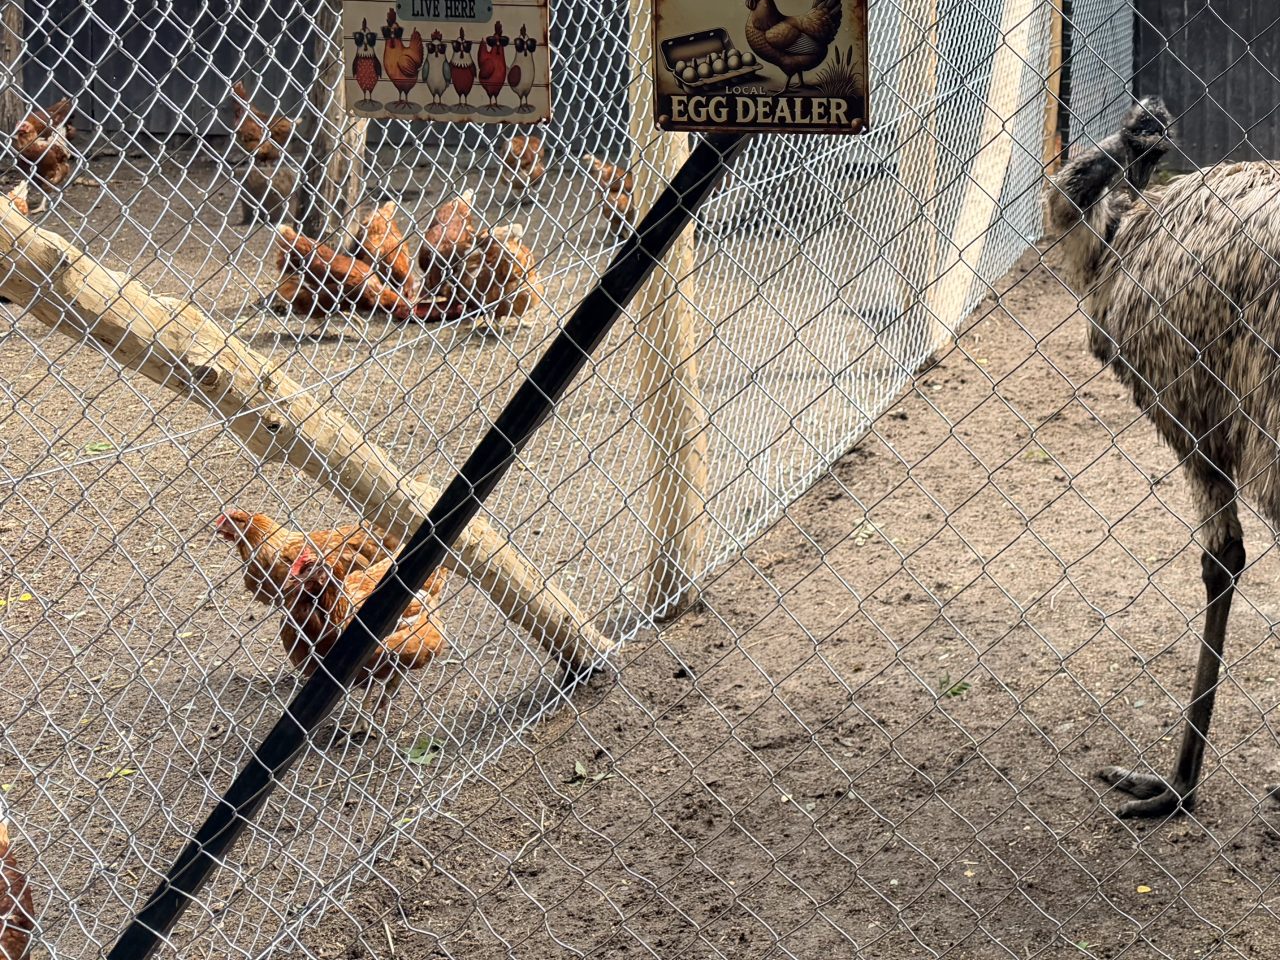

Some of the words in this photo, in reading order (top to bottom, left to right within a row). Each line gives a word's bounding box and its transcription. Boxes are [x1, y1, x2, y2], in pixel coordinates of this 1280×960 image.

[725, 85, 767, 95] LOCAL
[670, 95, 730, 122] EGG
[735, 96, 851, 125] DEALER
